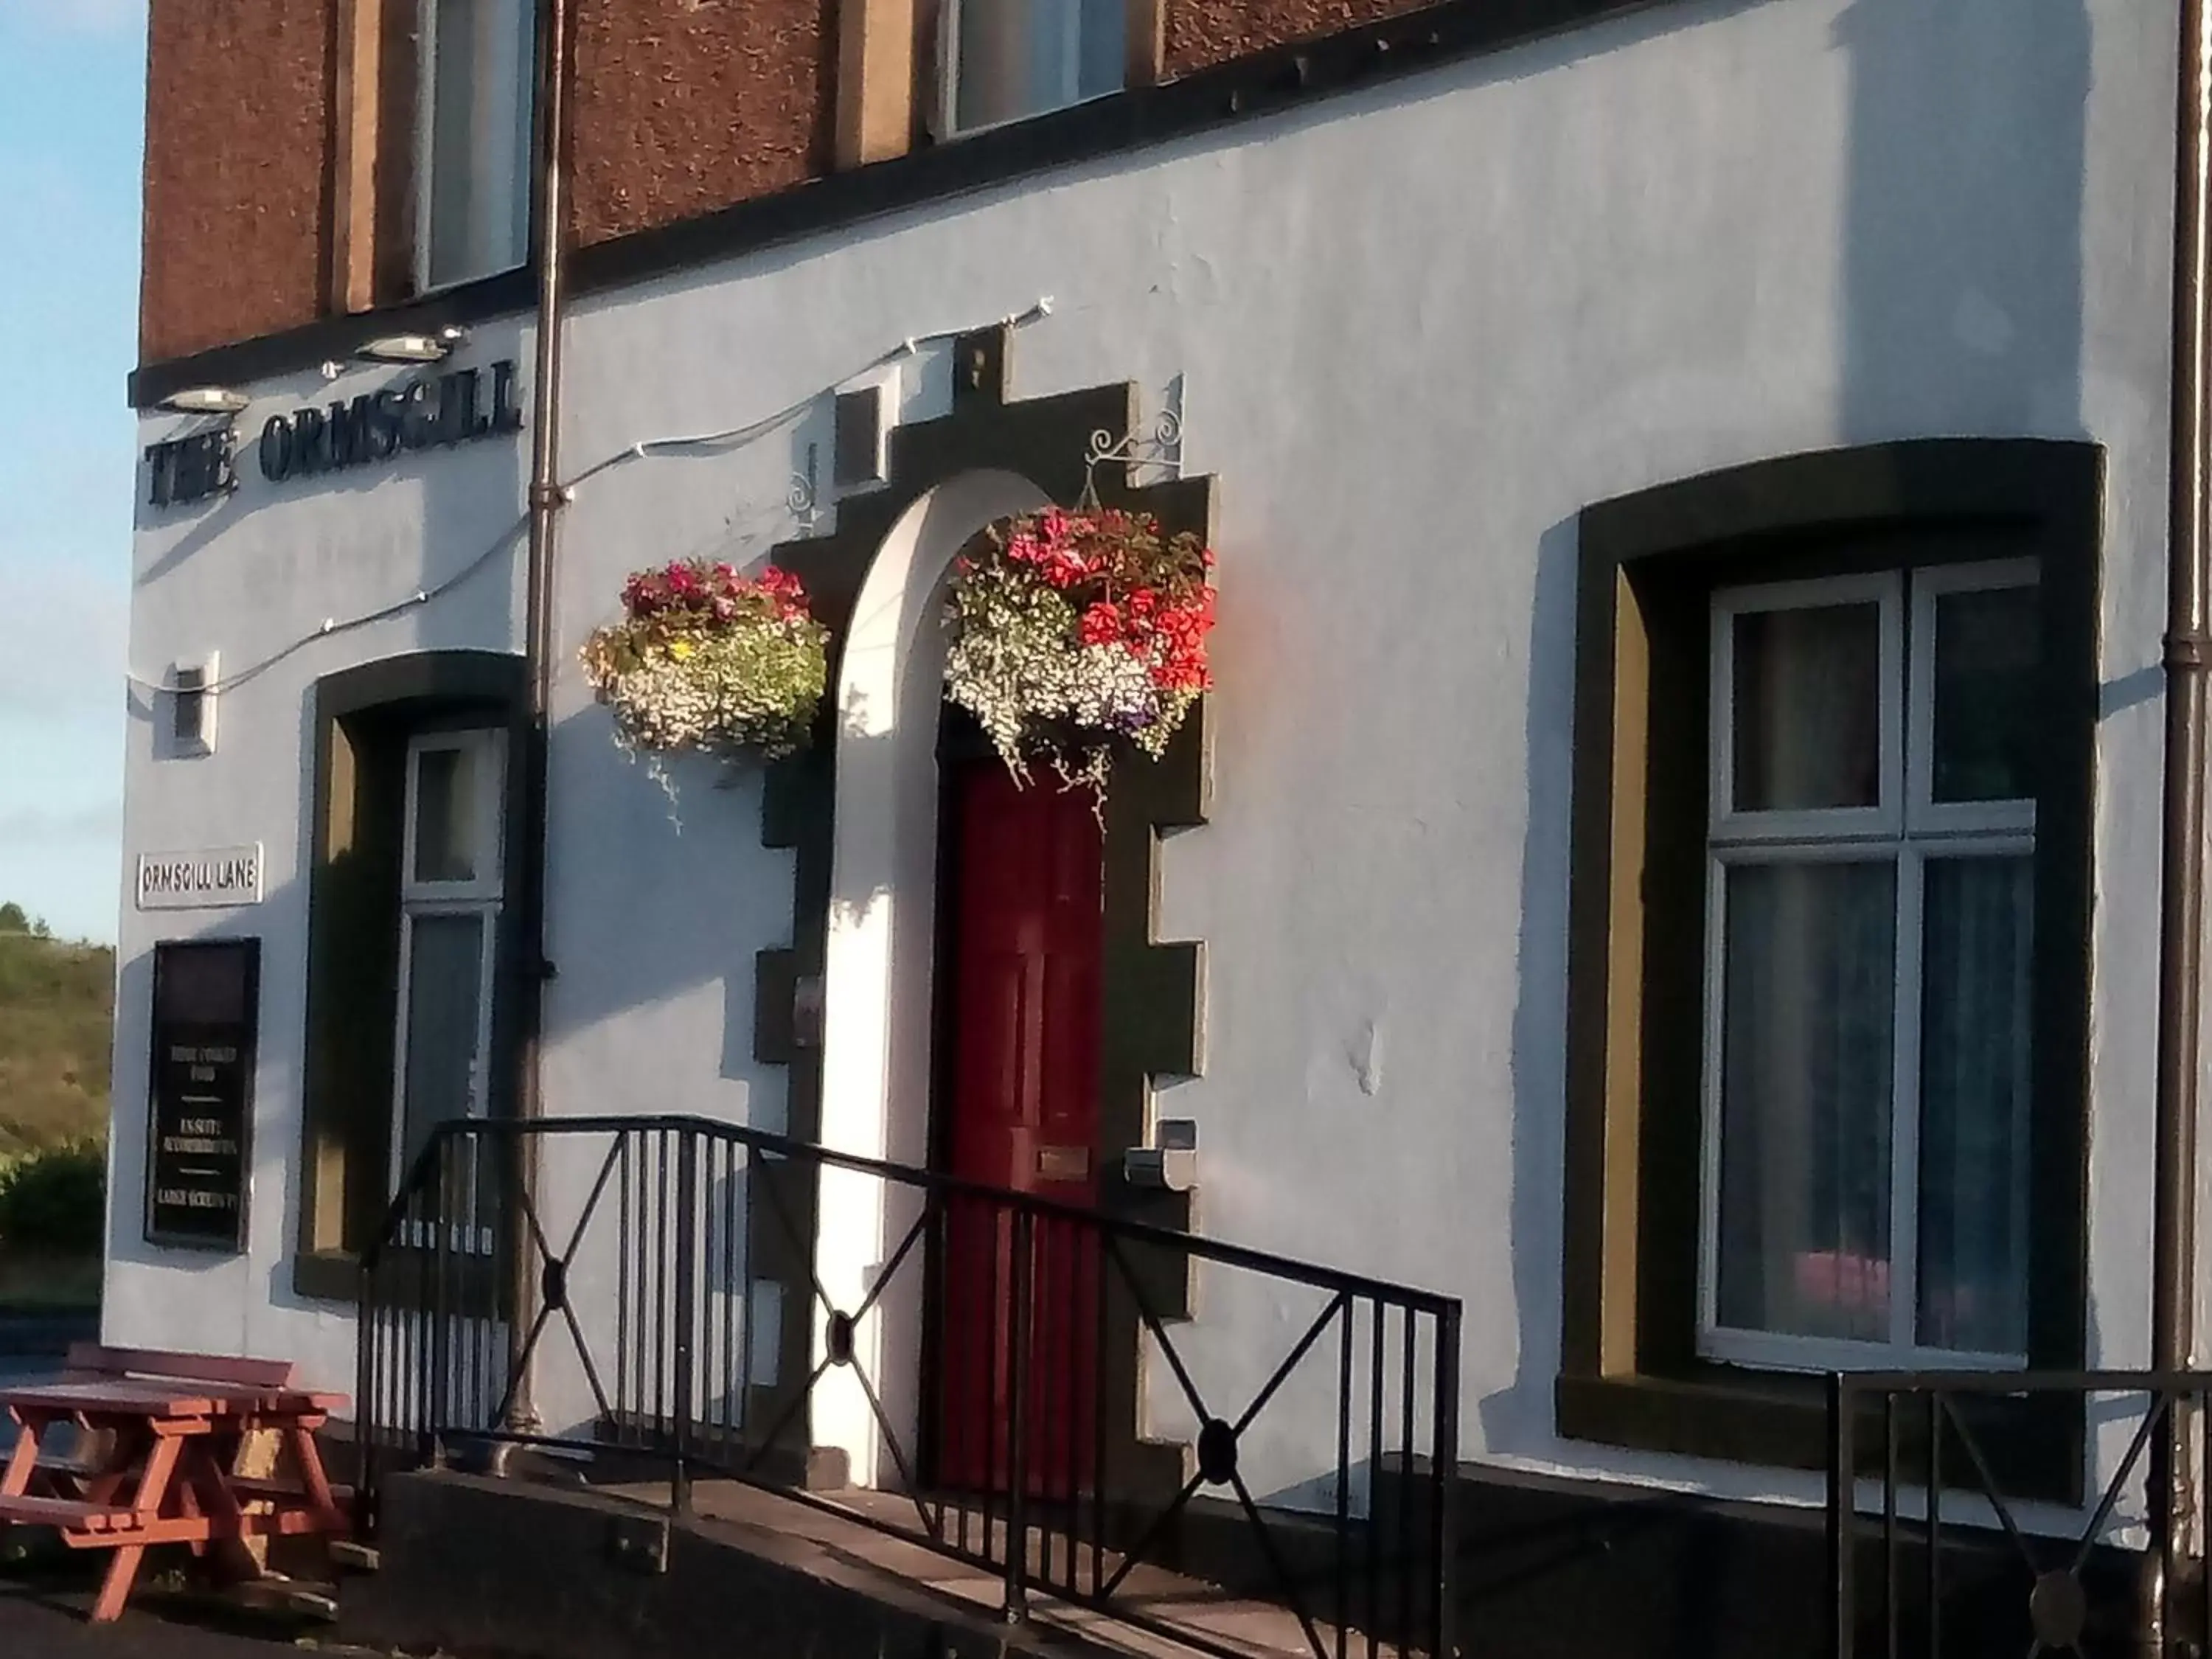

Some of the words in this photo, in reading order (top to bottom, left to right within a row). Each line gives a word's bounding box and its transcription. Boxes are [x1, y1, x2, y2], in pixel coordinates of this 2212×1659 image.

[145, 428, 240, 507] THE
[259, 358, 525, 482] ORMSGILL
[143, 863, 212, 893] ORMSGILL
[217, 858, 256, 889] LANE
